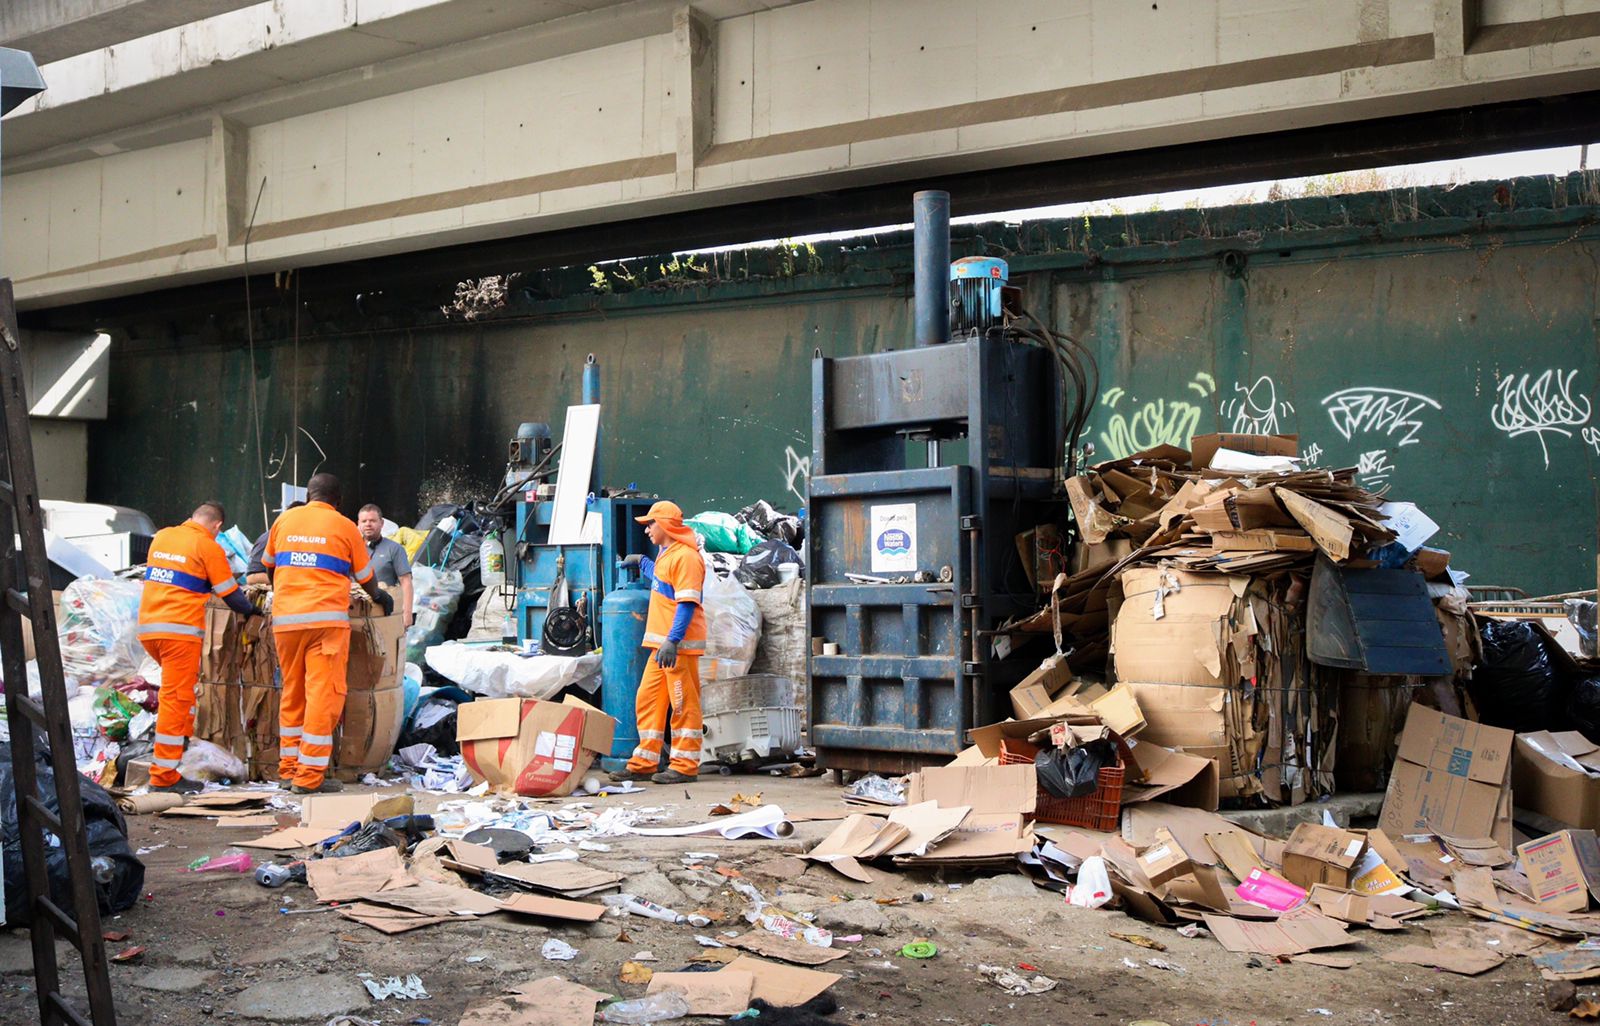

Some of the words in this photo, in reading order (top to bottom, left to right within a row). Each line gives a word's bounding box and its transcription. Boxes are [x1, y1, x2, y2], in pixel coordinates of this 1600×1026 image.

[287, 535, 327, 545] COMLURB
[153, 551, 186, 563] COMLURB
[291, 552, 309, 563] RIO
[150, 567, 168, 578] RIO
